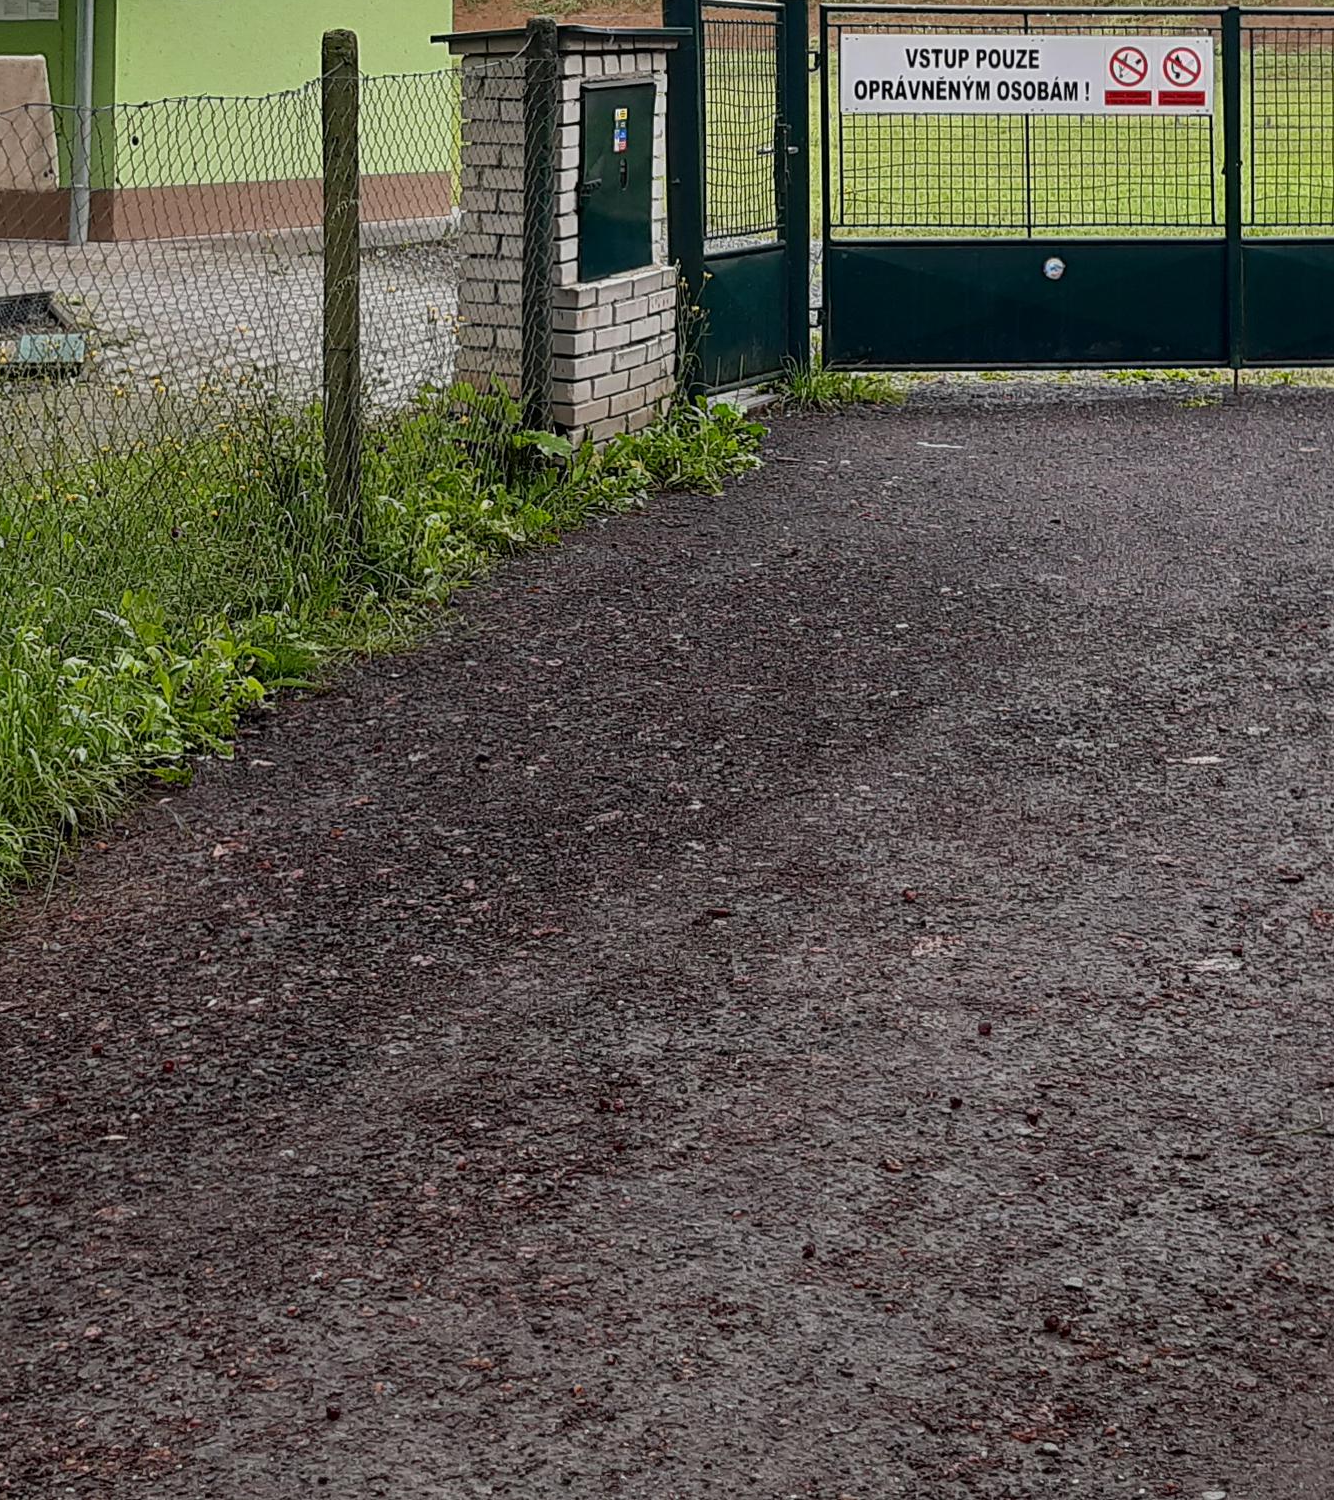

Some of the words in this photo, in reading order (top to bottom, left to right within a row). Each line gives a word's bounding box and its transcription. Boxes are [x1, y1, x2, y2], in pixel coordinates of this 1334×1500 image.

[905, 48, 970, 69] VSTUP
[976, 49, 1040, 70] POUZE
[854, 75, 990, 101] OPRÁVNĚNÝM
[996, 76, 1079, 102] OSOBÁM
[1084, 82, 1090, 102] !
